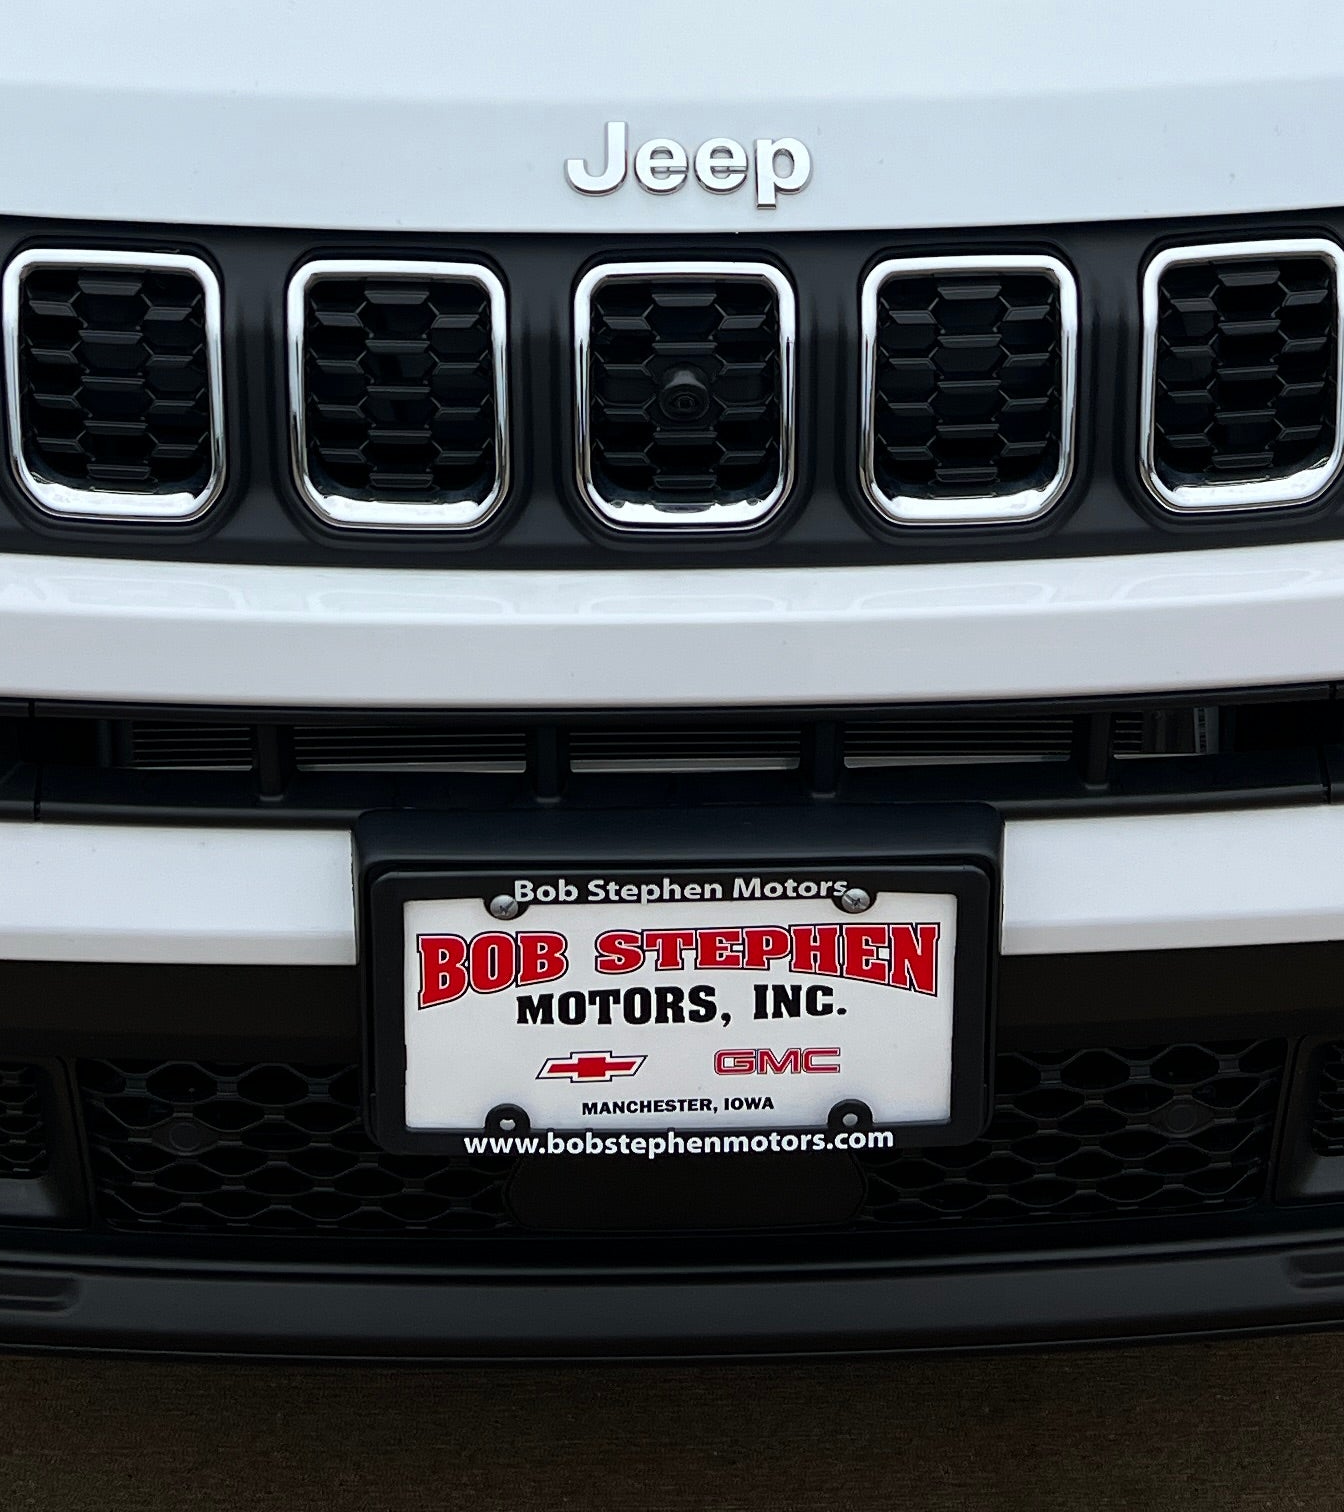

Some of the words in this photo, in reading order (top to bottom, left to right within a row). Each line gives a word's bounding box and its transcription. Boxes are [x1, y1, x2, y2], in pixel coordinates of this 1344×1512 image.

[565, 120, 813, 210] Jeep
[514, 879, 578, 903] Bob
[588, 878, 723, 904] Stephen
[733, 876, 847, 899] Motors
[416, 930, 568, 1009] BOB
[595, 923, 940, 998] STEPHEN
[516, 984, 731, 1028] MOTORS,
[753, 984, 847, 1020] INC.
[713, 1047, 841, 1075] GMC
[581, 1098, 718, 1116] MANCHESTER,
[724, 1096, 775, 1111] IOWA
[464, 1130, 894, 1159] www.bobstephenmotors.com
